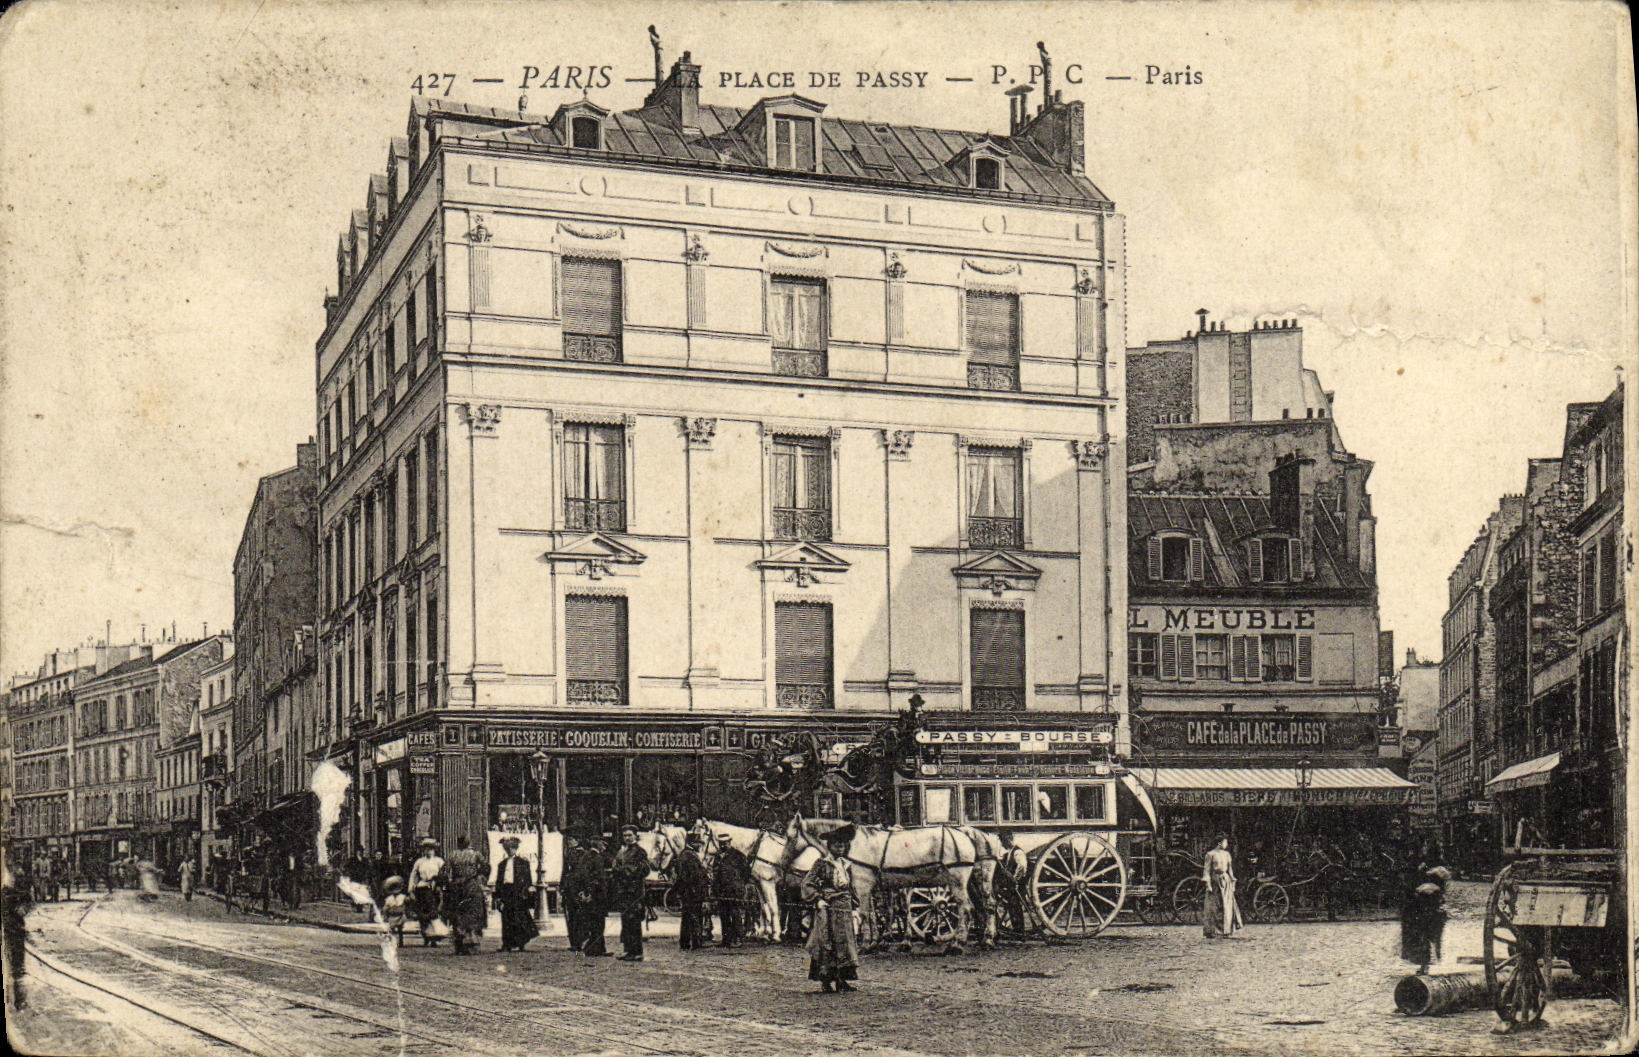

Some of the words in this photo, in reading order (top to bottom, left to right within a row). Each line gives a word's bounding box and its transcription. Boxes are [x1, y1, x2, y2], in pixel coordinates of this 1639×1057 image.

[489, 730, 558, 746] PATISSERIE
[565, 731, 627, 747] COQUELIN
[636, 732, 701, 748] CONFISERIE
[930, 732, 996, 742] PASSY
[1021, 732, 1100, 742] BOURSE
[1240, 722, 1276, 744] PLACE
[1290, 722, 1326, 744] PASSY
